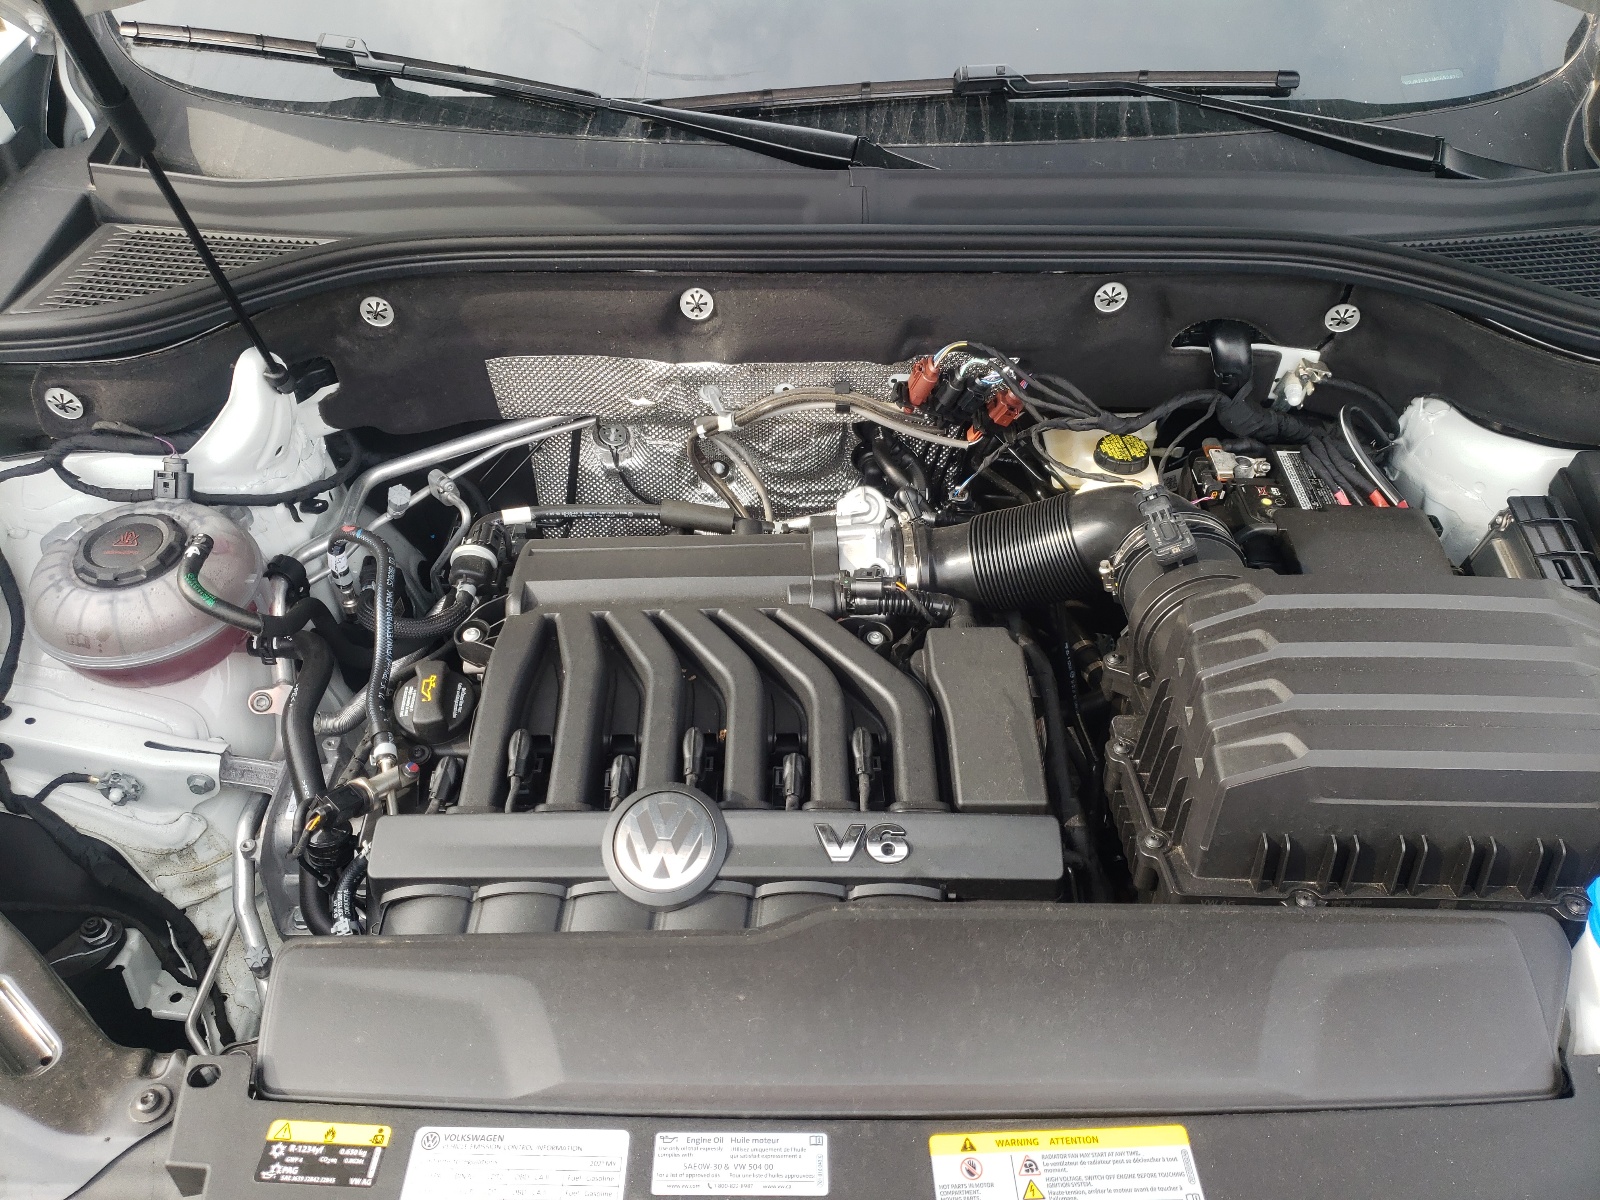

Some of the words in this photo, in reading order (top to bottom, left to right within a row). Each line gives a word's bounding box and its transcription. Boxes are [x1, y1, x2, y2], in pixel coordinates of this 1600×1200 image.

[814, 822, 910, 865] V6
[444, 1133, 505, 1142] VOLKSWAGEN
[686, 1136, 712, 1146] Engine
[713, 1136, 724, 1144] Oil
[730, 1136, 750, 1144] Huile
[1049, 1136, 1099, 1146] ATTENTION
[995, 1138, 1039, 1148] WARNING
[288, 1144, 325, 1155] R-1234yf
[733, 1163, 747, 1171] VW
[748, 1163, 762, 1171] 504
[763, 1163, 774, 1171] 00
[349, 1177, 362, 1186] VW
[362, 1178, 373, 1187] AG
